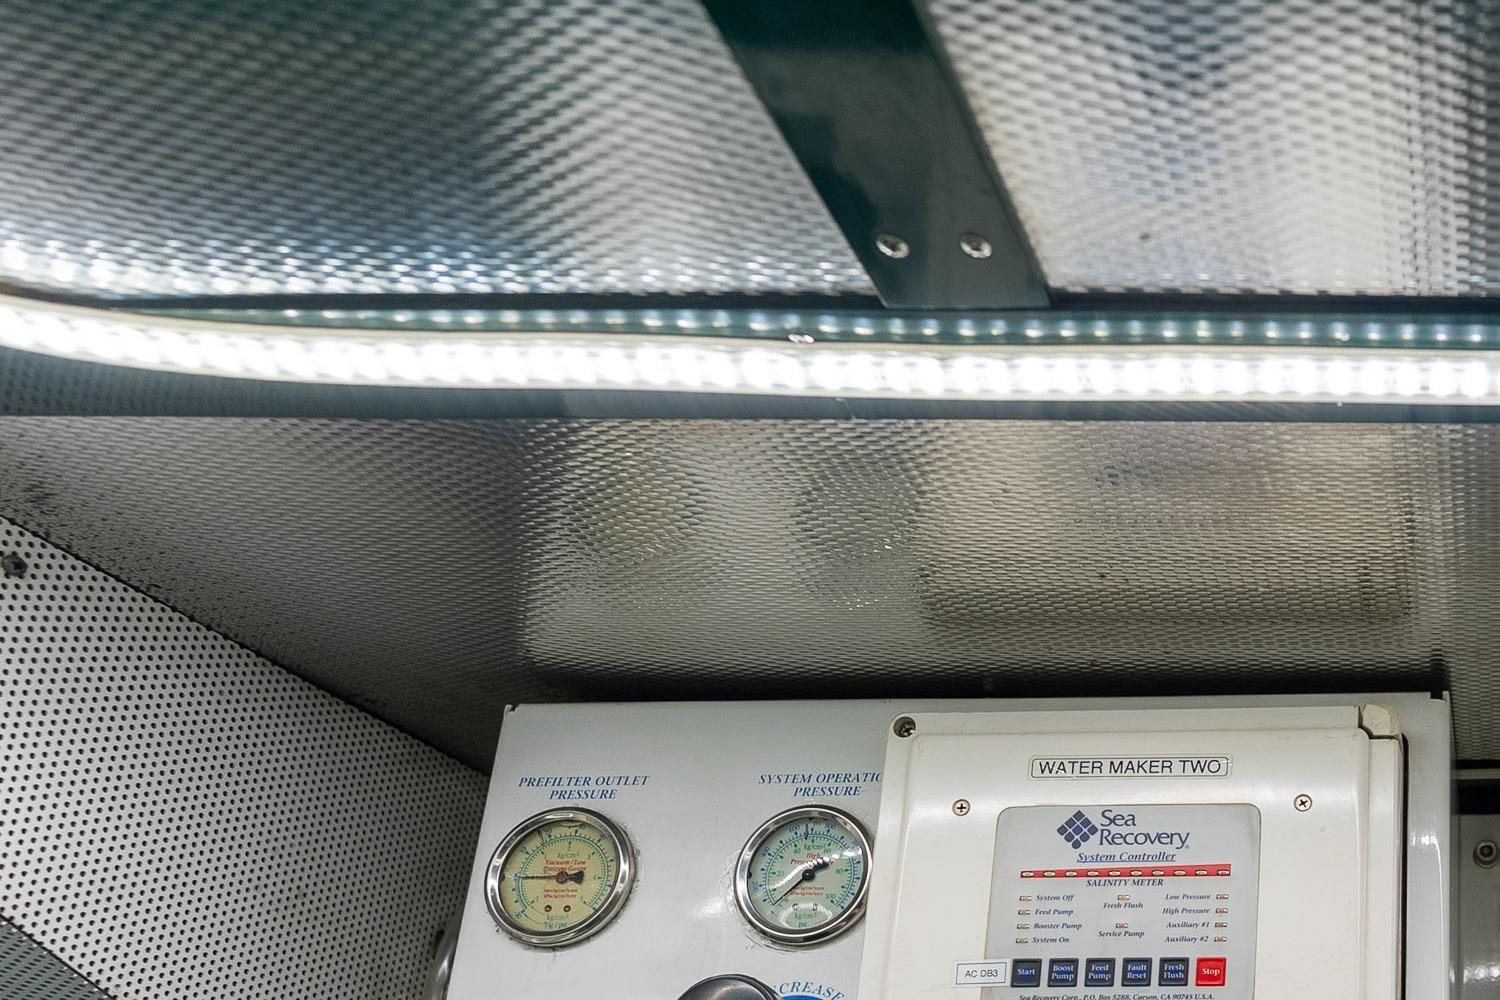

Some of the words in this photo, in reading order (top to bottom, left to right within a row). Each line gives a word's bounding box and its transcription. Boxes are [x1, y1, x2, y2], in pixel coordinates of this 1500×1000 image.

[1038, 760, 1103, 776] WATER
[1109, 759, 1173, 775] MAKER
[1178, 759, 1222, 774] TWO
[519, 776, 591, 788] PREFILTER
[595, 776, 650, 787] OUTLET
[758, 774, 812, 785] SYSTEM
[549, 789, 617, 800] PRESSURE
[793, 786, 861, 797] PRESSURE
[1100, 810, 1136, 827] Sea
[1100, 829, 1190, 850] Recovery
[1077, 852, 1116, 862] System
[1119, 852, 1176, 862] Controller
[1086, 879, 1130, 887] SALINITY
[1133, 878, 1164, 886] METER
[1036, 894, 1060, 902] System
[1061, 894, 1075, 902] Off
[1034, 908, 1052, 916] Feed
[1053, 908, 1074, 917] Pump
[1162, 907, 1180, 915] High
[1033, 922, 1062, 930] Booster
[1063, 922, 1082, 930] Pump
[1098, 930, 1122, 938] Service
[1124, 930, 1144, 938] Pump
[1032, 936, 1054, 944] System
[1056, 936, 1070, 944] On
[1016, 968, 1036, 976] Start
[1053, 964, 1074, 972] Boost
[1091, 964, 1109, 972] Feed
[1128, 963, 1147, 972] Fault
[1201, 968, 1220, 976] Stop
[964, 970, 978, 978] AC
[980, 968, 999, 978] DB3
[1051, 972, 1075, 981] Pump
[1088, 972, 1112, 980] Pump
[1127, 972, 1147, 980] Reset
[1164, 971, 1184, 979] Flush
